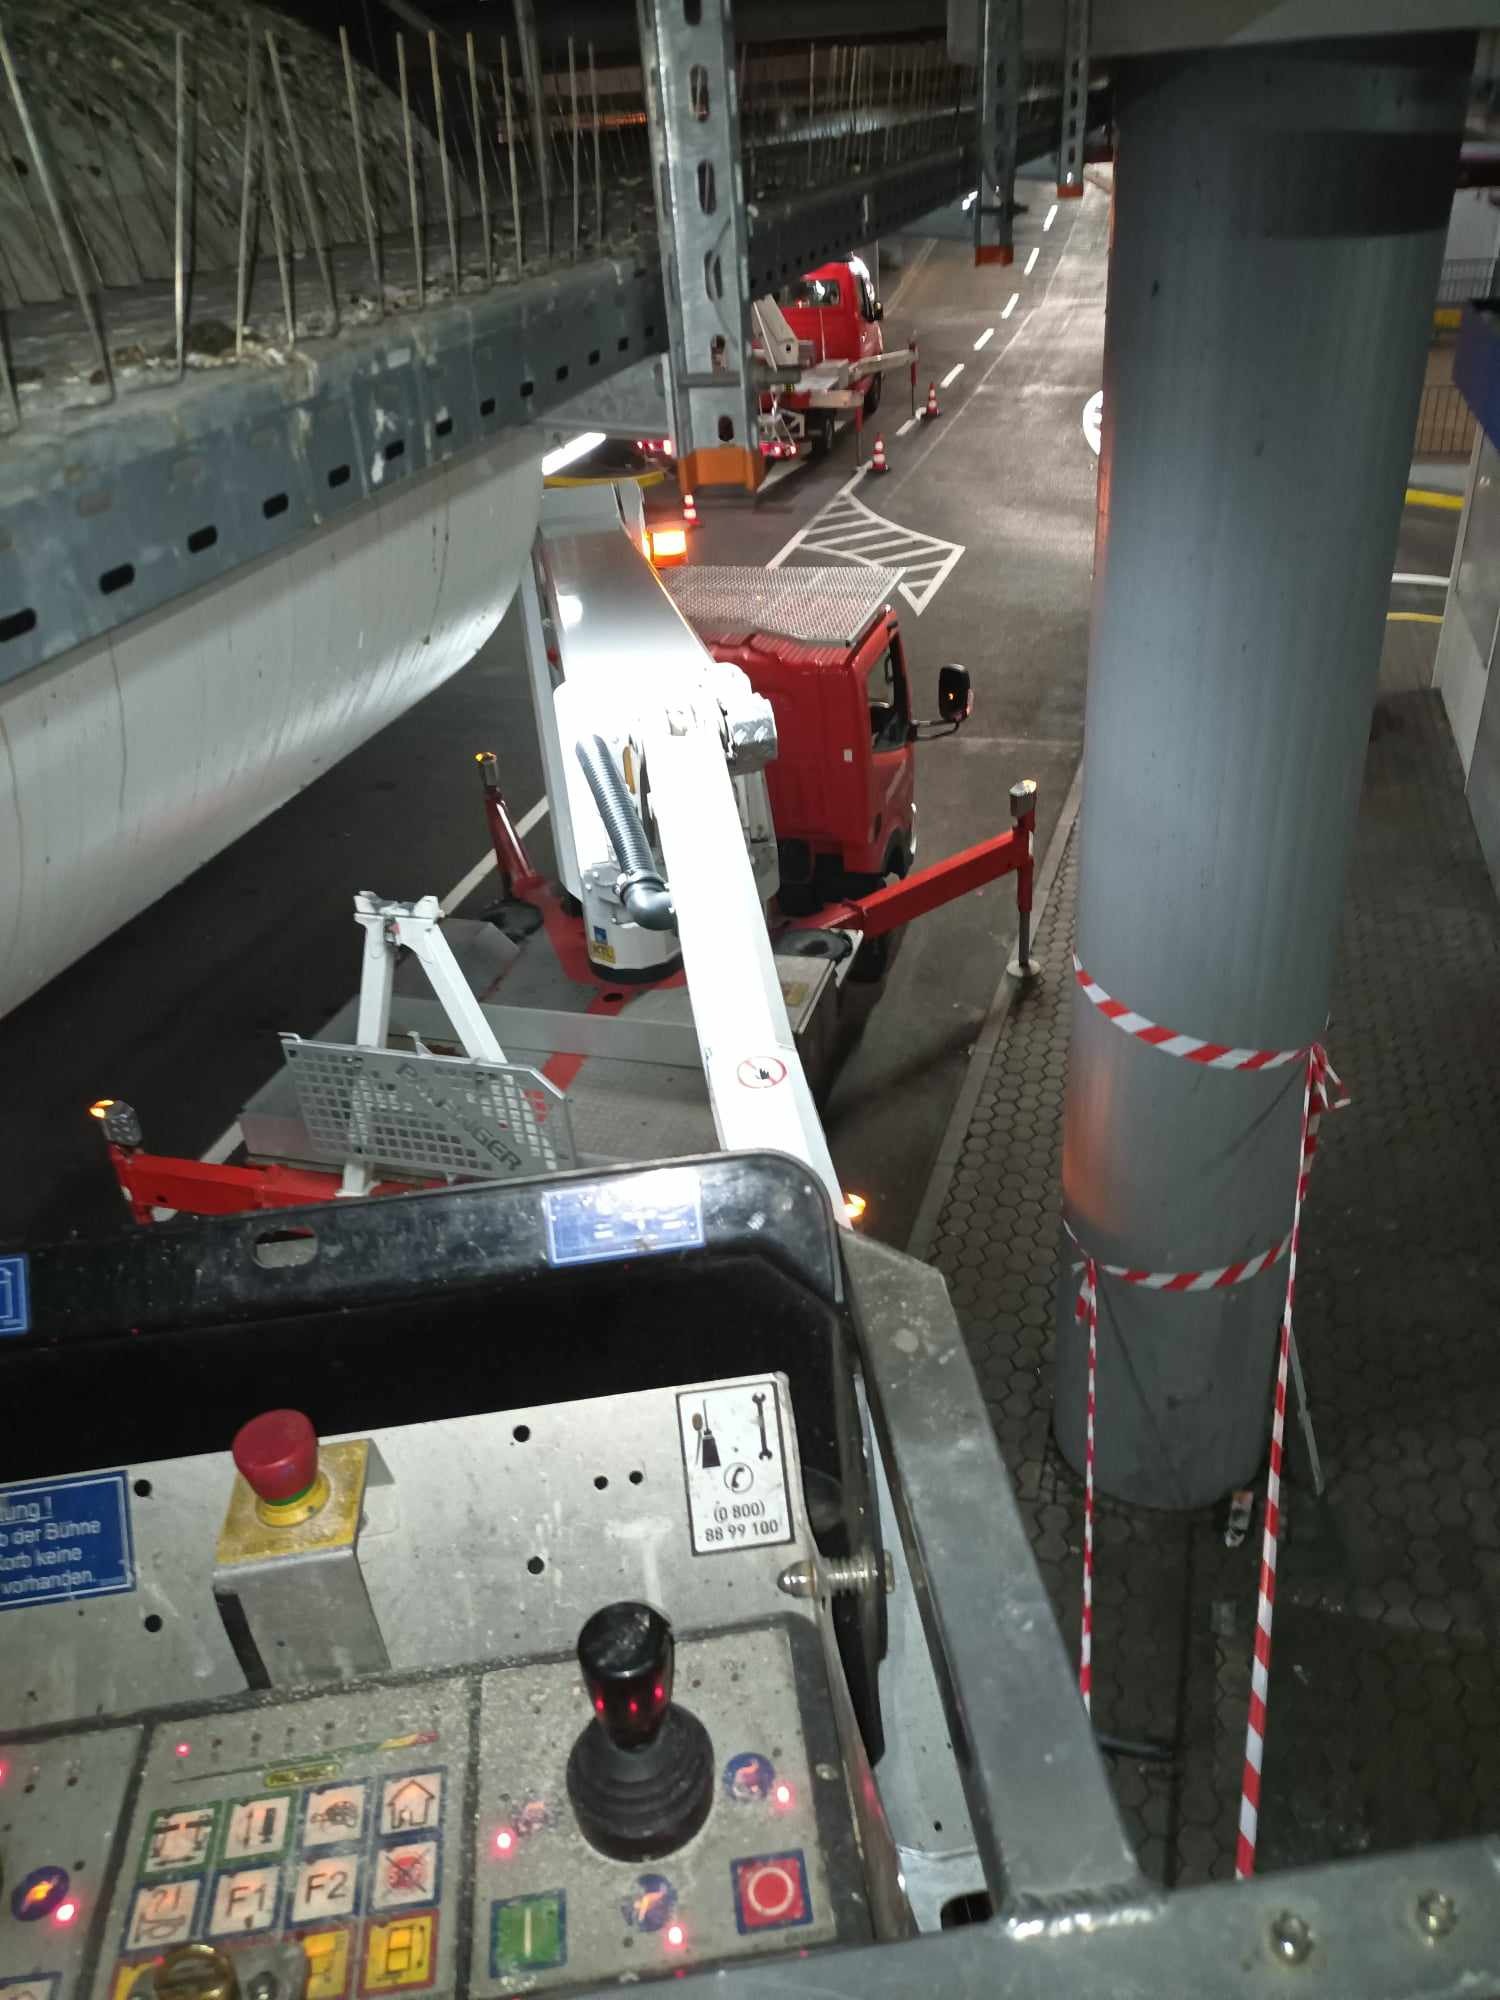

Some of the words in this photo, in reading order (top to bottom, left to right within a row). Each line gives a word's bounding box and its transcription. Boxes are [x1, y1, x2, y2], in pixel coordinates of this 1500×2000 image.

[714, 1506, 728, 1523] (0
[732, 1500, 765, 1519] 800)
[12, 1526, 42, 1545] der
[44, 1520, 101, 1540] Bühne
[704, 1526, 724, 1543] 88
[727, 1523, 746, 1540] 99
[752, 1519, 779, 1536] 100
[36, 1546, 83, 1567] keine
[304, 1869, 350, 1905] F2
[225, 1885, 267, 1917] F1
